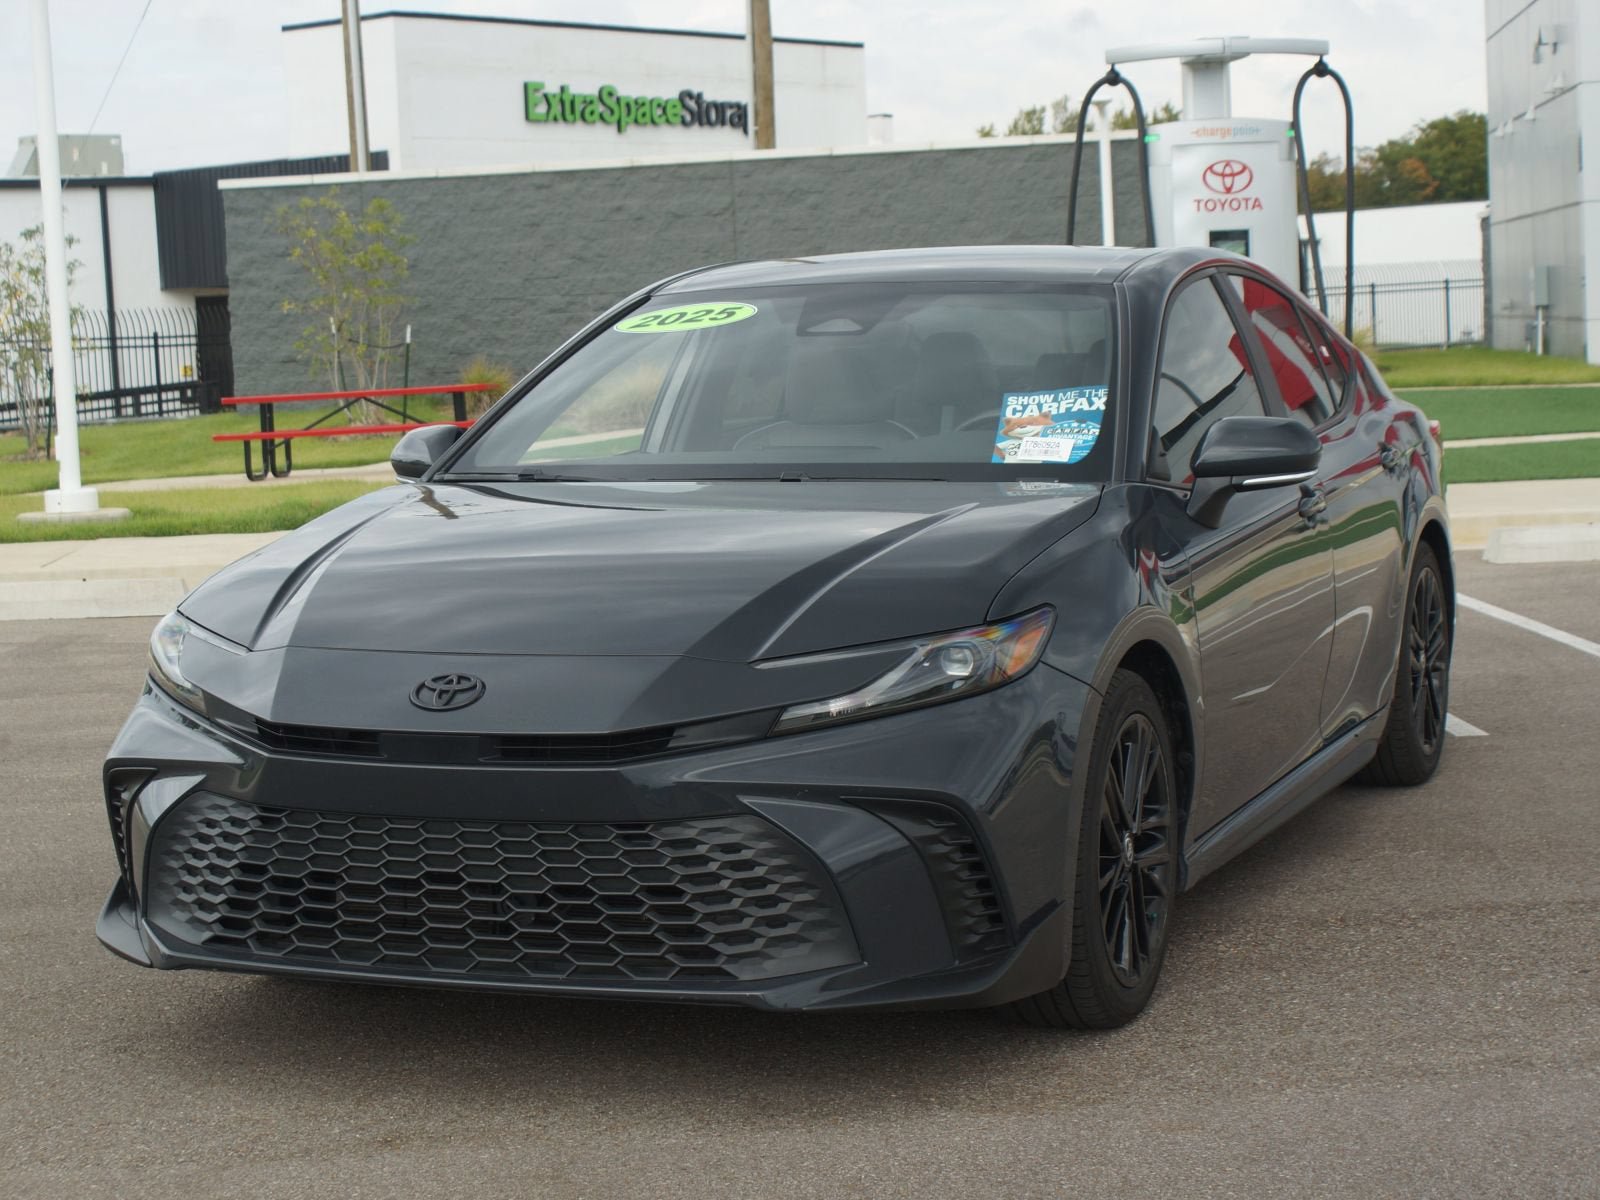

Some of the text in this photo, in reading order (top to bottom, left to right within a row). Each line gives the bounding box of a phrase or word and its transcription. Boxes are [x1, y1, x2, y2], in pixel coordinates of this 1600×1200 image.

[1193, 197, 1263, 212] TOYOTA
[626, 306, 743, 329] 2025
[1007, 388, 1109, 405] SHOW ME THE
[1005, 396, 1107, 418] CARFAX
[1047, 427, 1100, 436] CARFAX
